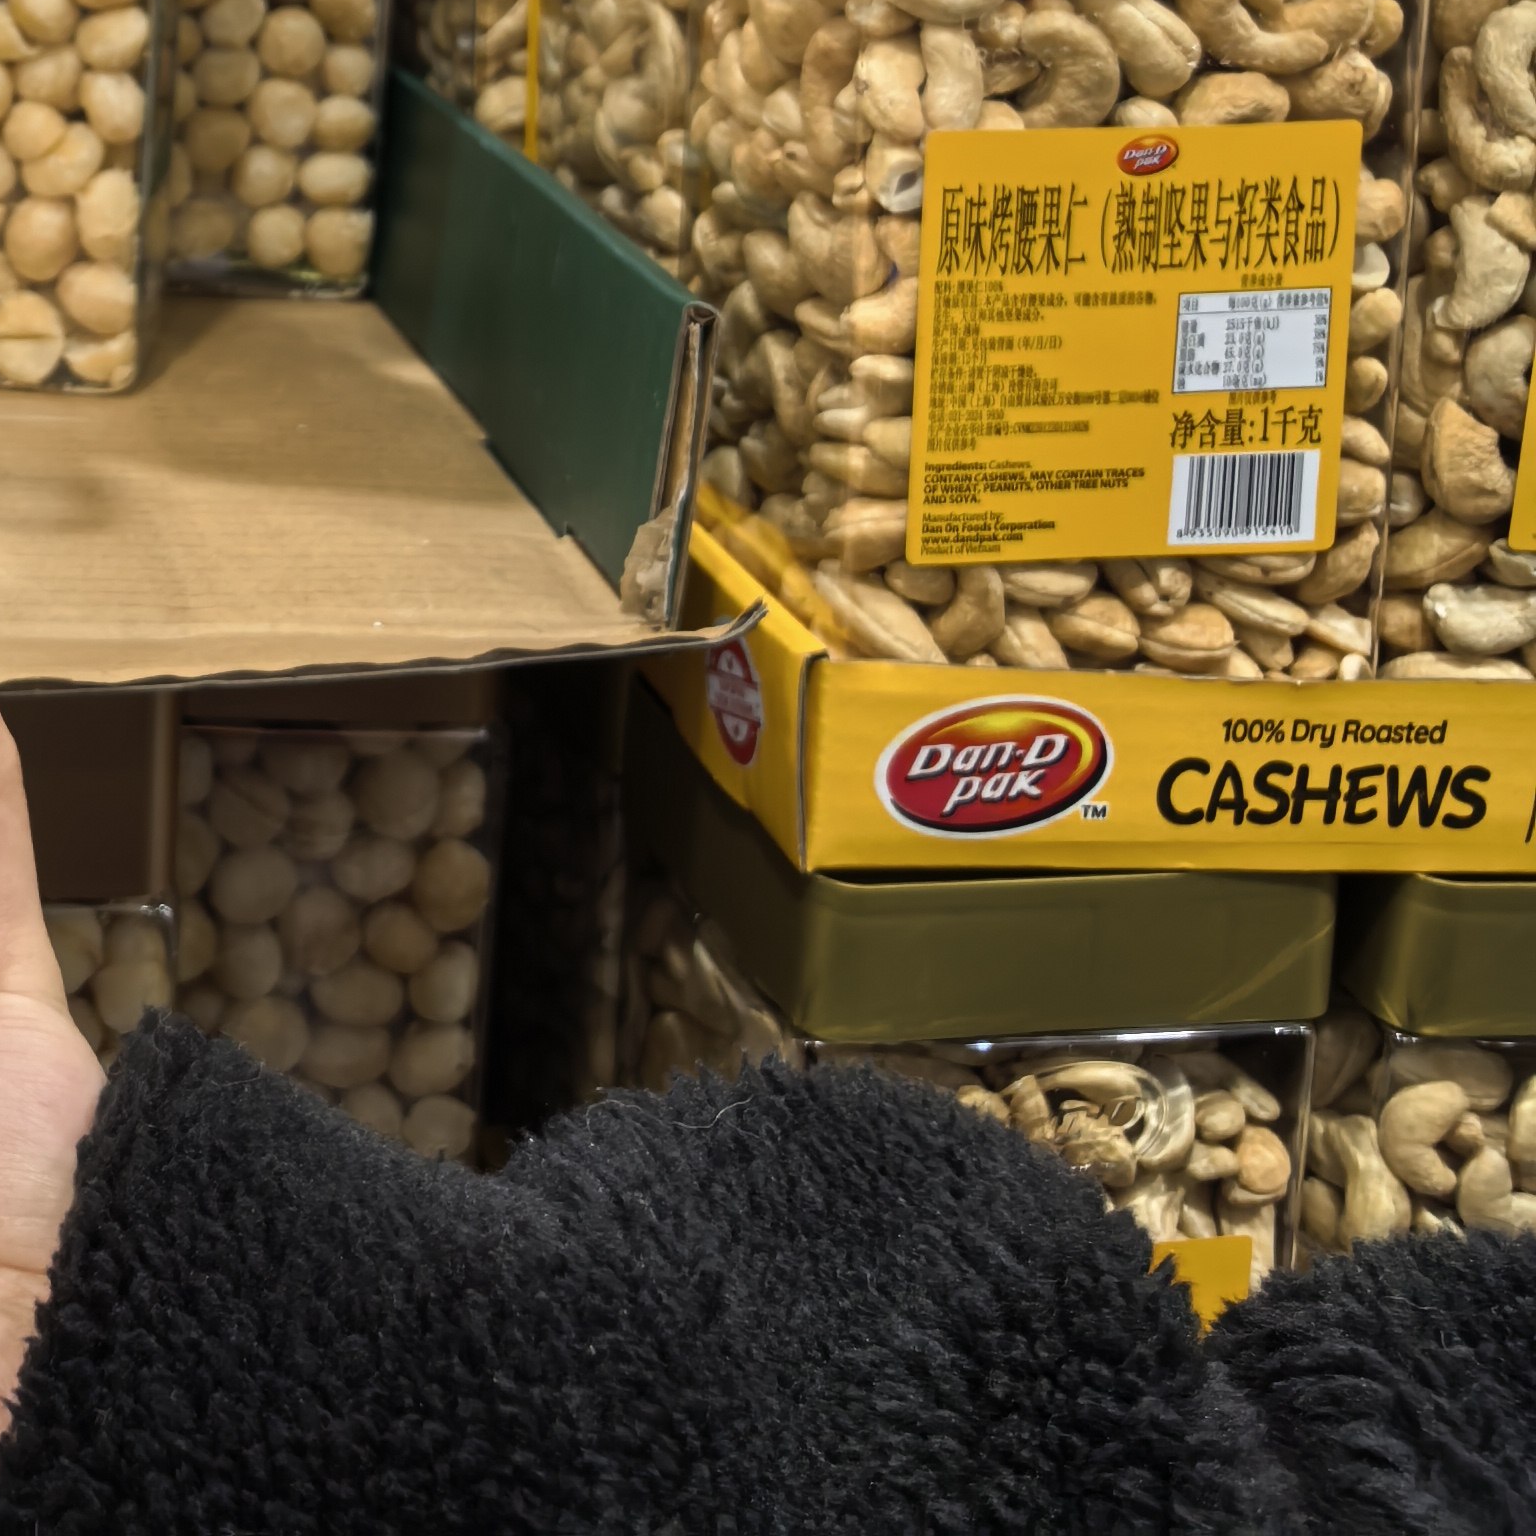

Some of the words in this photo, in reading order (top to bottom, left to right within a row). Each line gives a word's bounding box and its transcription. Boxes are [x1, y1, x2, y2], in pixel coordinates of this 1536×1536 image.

[924, 473, 973, 483] CONTAIN
[1030, 470, 1053, 480] MAY
[1055, 469, 1103, 479] CONTAIN
[1106, 467, 1145, 478] TRACES
[924, 484, 938, 494] OF
[1036, 480, 1071, 490] OTHER
[1074, 479, 1098, 490] TREE
[1100, 478, 1129, 488] NUTS
[923, 494, 947, 504] AND
[922, 523, 943, 533] Dan
[1222, 718, 1285, 744] 100%
[1290, 719, 1337, 749] Dry
[1342, 718, 1448, 745] Roasted
[940, 768, 1046, 817] pak
[1156, 756, 1492, 830] CASHEWS
[1081, 803, 1107, 820] TM
